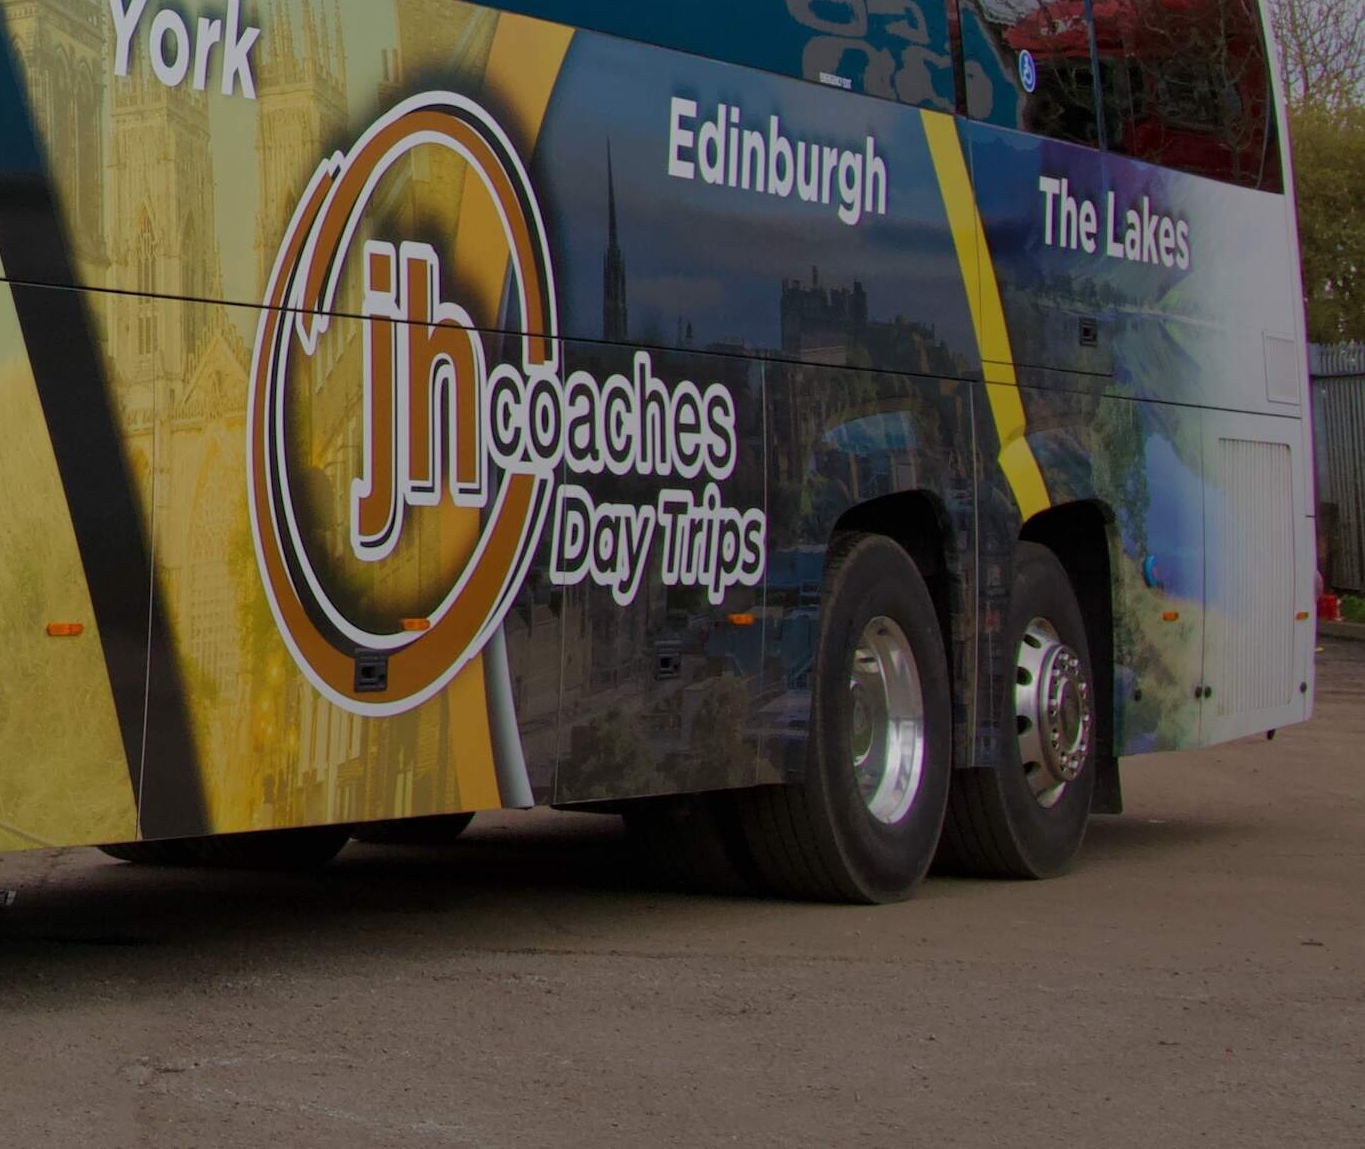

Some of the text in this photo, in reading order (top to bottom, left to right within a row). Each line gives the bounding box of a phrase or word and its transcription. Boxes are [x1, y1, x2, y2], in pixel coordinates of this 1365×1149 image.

[667, 96, 888, 226] Edinburgh
[1038, 175, 1190, 270] The Lakes
[352, 240, 489, 561] jh
[488, 351, 736, 480] coaches
[550, 482, 766, 606] Day Trips
